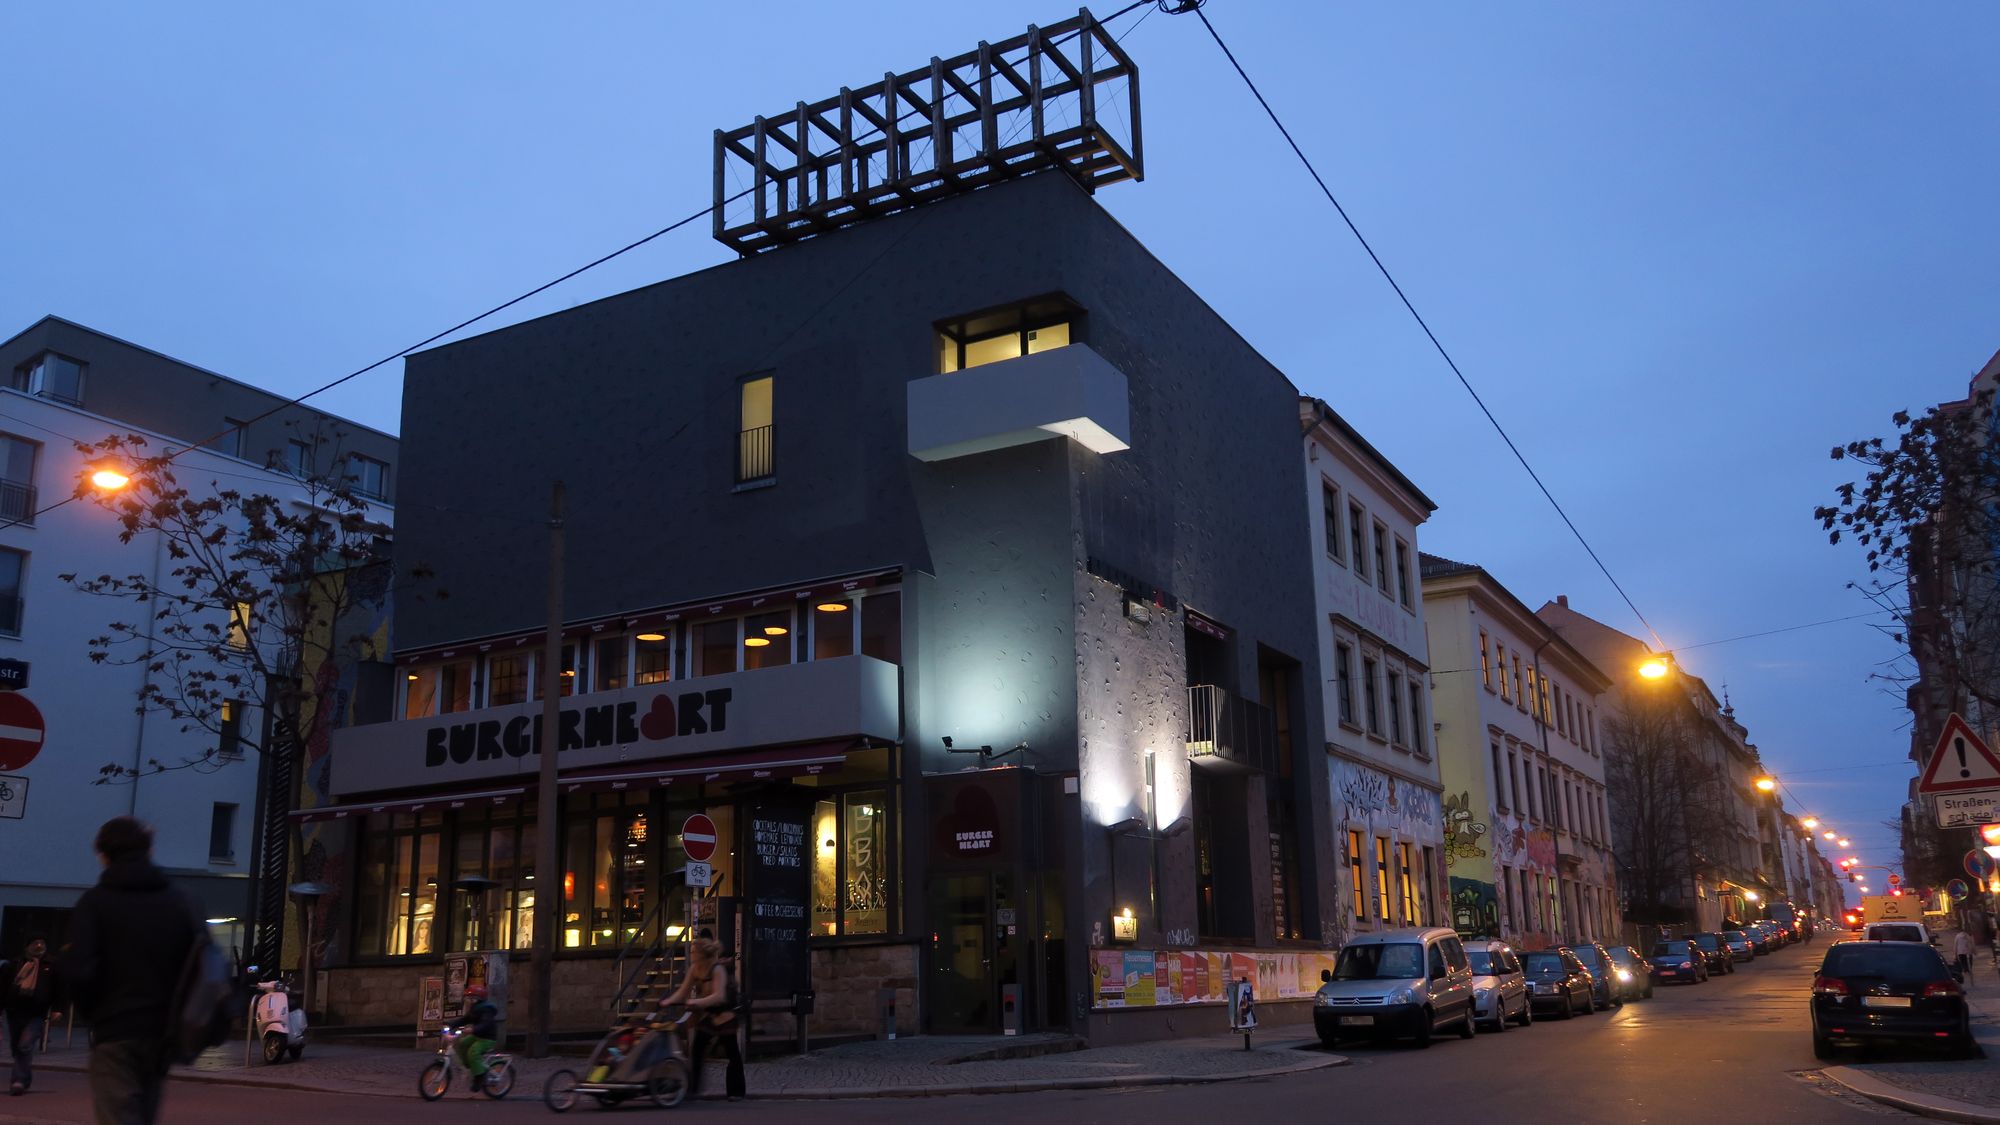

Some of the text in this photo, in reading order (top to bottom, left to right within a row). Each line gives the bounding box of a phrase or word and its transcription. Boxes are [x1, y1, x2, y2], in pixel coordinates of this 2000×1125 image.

[1944, 797, 1997, 808] Straßen-
[956, 830, 994, 841] BURGER
[959, 840, 991, 850] HEART
[763, 856, 800, 866] FRIED POTATOES
[755, 904, 774, 916] COFFEE
